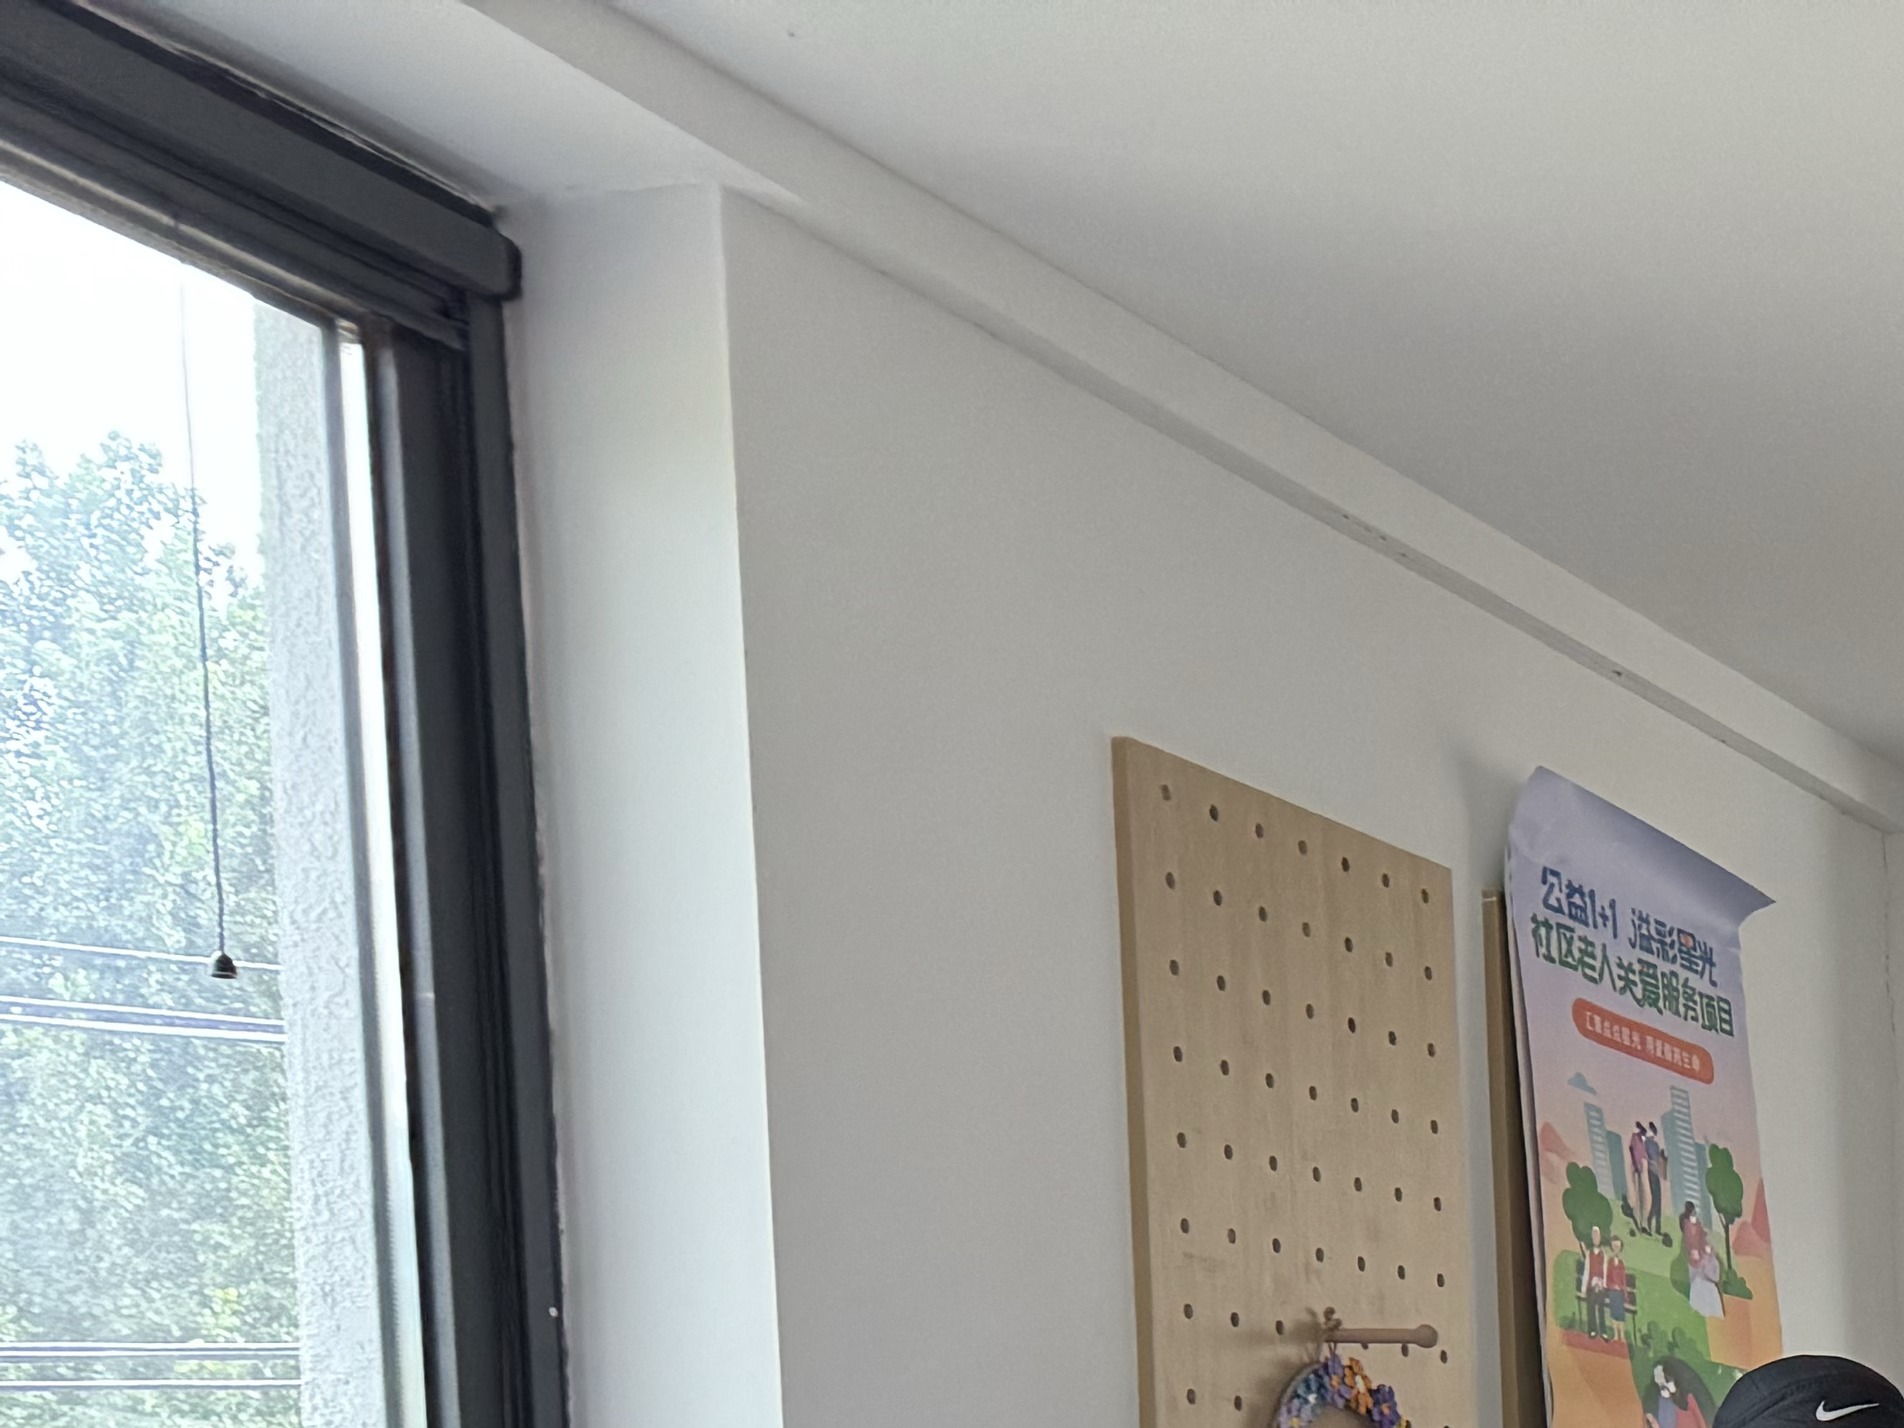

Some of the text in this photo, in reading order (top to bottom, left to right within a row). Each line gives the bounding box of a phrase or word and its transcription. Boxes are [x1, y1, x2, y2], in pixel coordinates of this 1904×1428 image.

[1530, 912, 1735, 1038] 社区老人关爱服务项目
[1628, 907, 1718, 988] 溢彩星光
